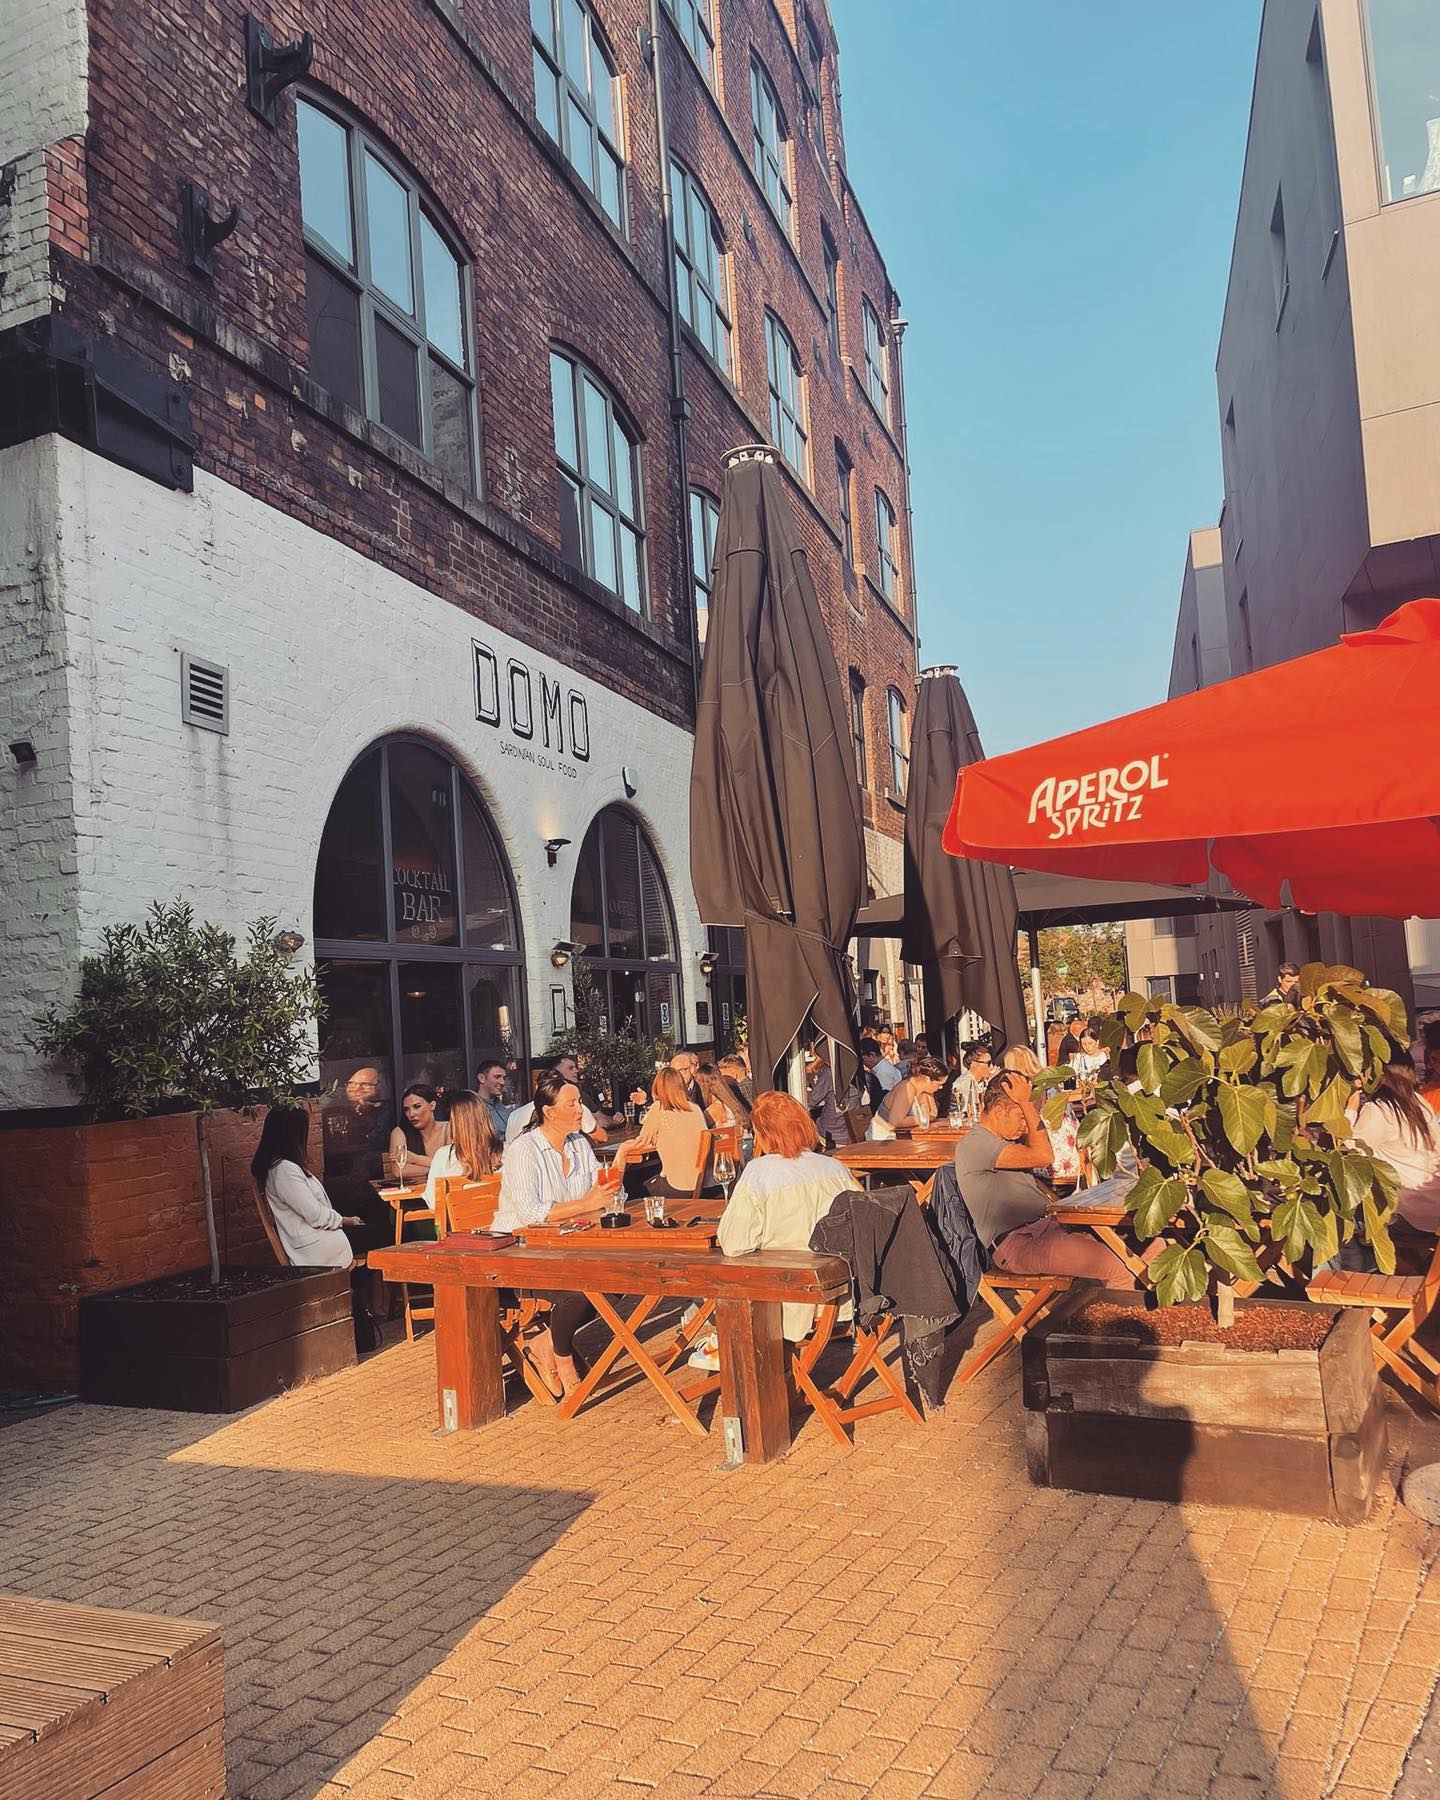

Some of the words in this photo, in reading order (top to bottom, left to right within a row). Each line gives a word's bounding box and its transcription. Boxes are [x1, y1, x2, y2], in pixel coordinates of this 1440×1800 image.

[471, 637, 590, 763] DOMO
[500, 740, 535, 763] SARDINIAN
[537, 754, 555, 771] SOUL
[558, 762, 577, 779] FOOD
[1027, 755, 1169, 824] APEROL
[392, 866, 451, 893] COCKTAIL
[402, 891, 444, 923] BAR
